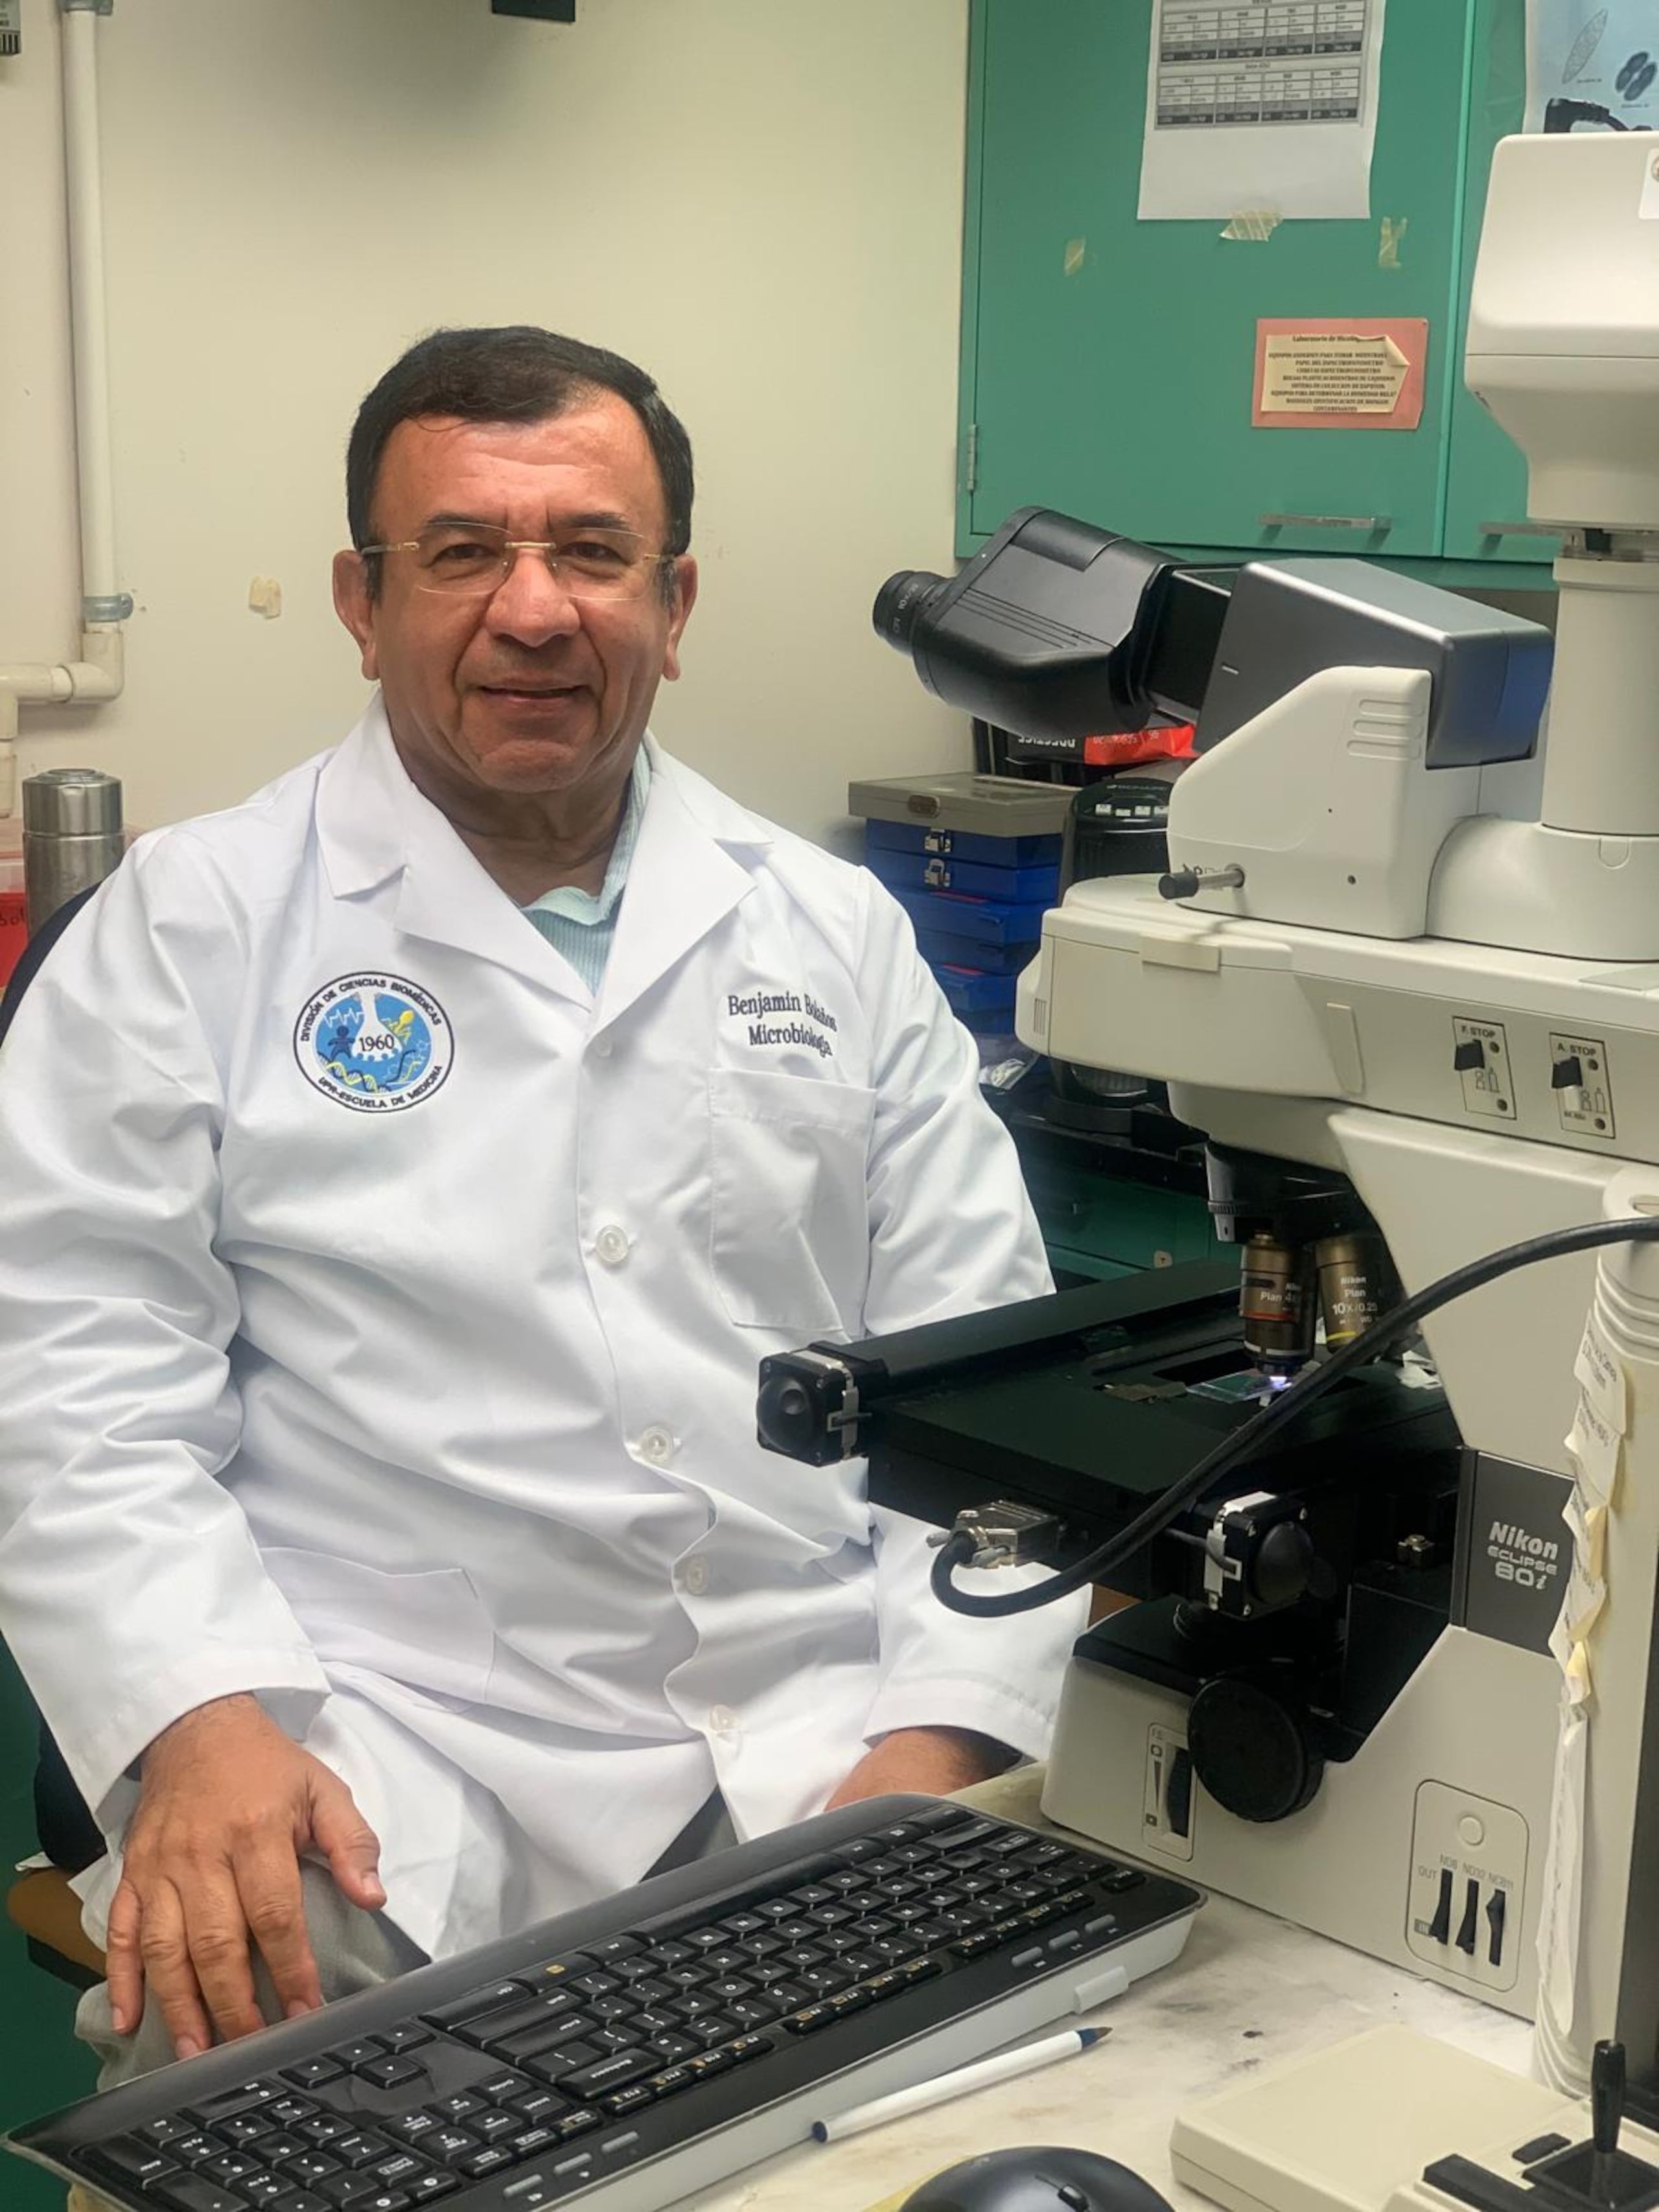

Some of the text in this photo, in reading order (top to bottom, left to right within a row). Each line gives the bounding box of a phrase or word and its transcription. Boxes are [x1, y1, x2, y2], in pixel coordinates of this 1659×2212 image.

[301, 978, 442, 1042] DIVISIÓN DE CIENCIAS BIOMÉDICAS
[728, 990, 802, 1019] Benjamin
[360, 1034, 395, 1053] 1960
[1470, 1026, 1496, 1038] STOP
[1570, 1045, 1597, 1056] STOP
[318, 1064, 443, 1109] UPR-ESCUELA DE MEDICINA
[1260, 1291, 1282, 1302] Plan
[1344, 1288, 1366, 1298] Plan
[1489, 1521, 1559, 1561] Nikon
[1487, 1545, 1558, 1576] ECLIPSE
[1494, 1561, 1548, 1590] 80i
